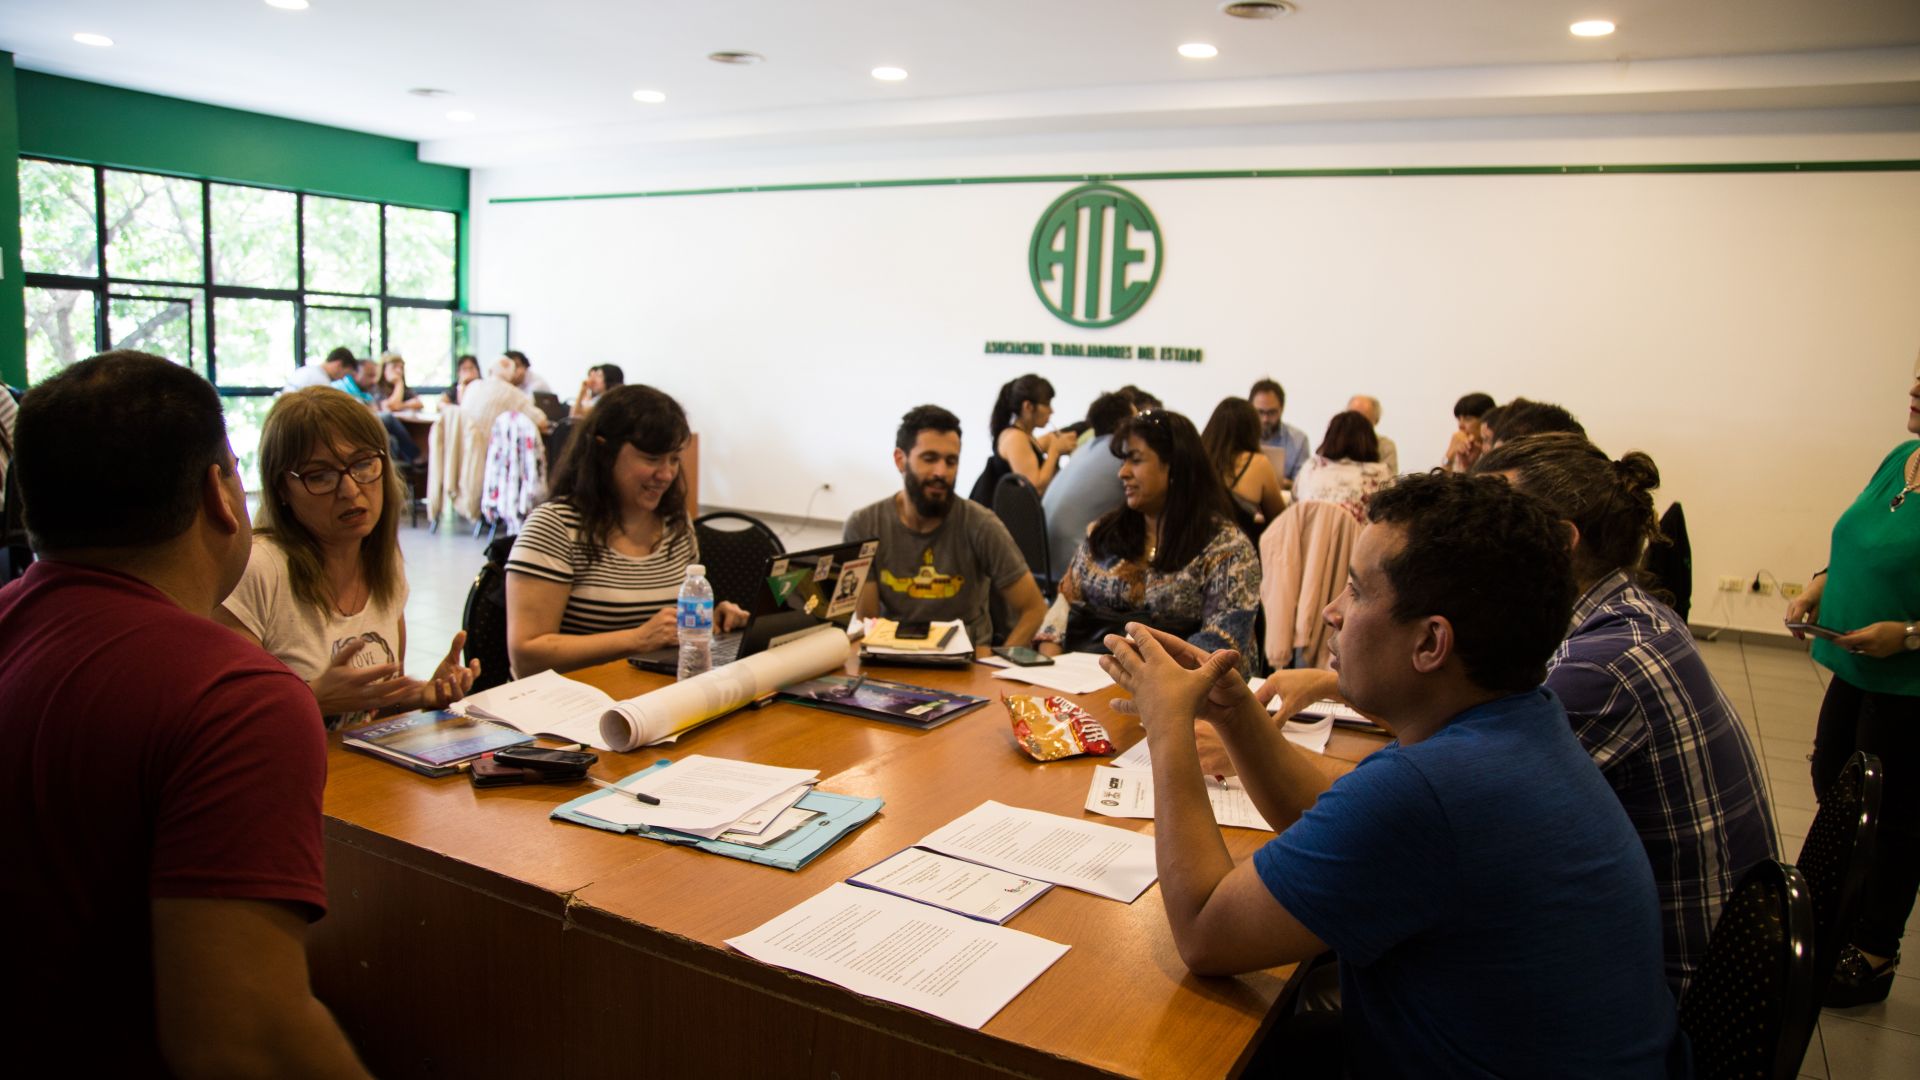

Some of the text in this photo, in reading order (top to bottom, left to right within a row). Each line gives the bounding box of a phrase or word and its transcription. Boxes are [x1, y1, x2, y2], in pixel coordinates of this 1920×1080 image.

[1036, 194, 1155, 320] ATE
[1051, 343, 1132, 360] TRABAJADORES
[1138, 347, 1155, 361] DEL
[1161, 348, 1203, 363] ESTADO
[351, 651, 376, 669] LOVE
[363, 719, 417, 738] 2018
